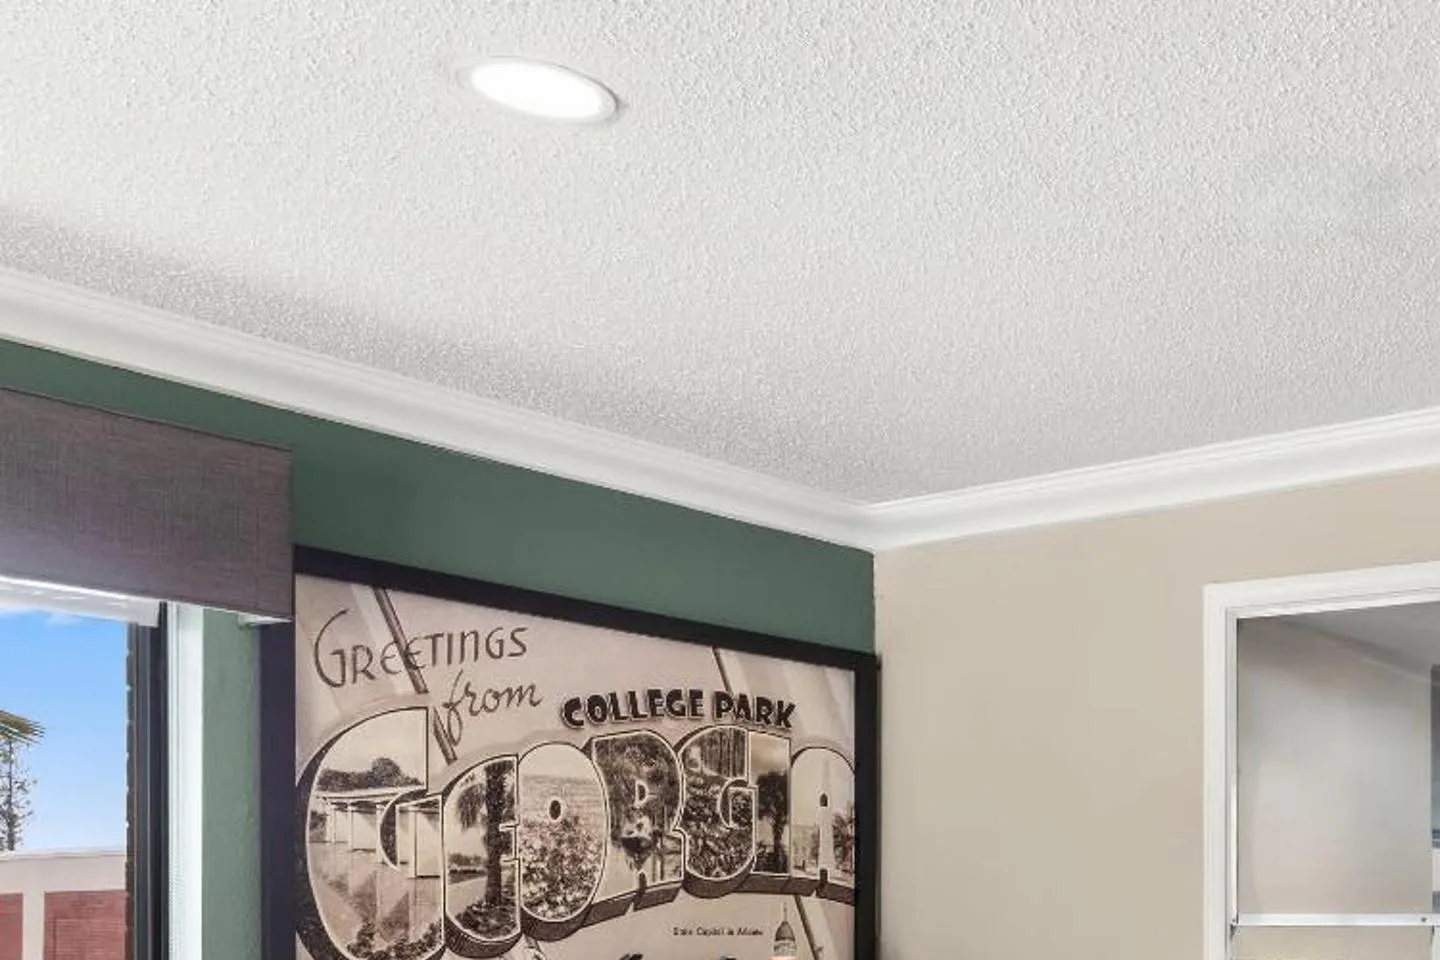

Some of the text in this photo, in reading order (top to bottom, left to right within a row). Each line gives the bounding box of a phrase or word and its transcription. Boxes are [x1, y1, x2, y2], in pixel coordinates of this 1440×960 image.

[314, 608, 529, 688] GREETINGS
[441, 669, 544, 746] from
[562, 688, 796, 729] COLLEGE PARK
